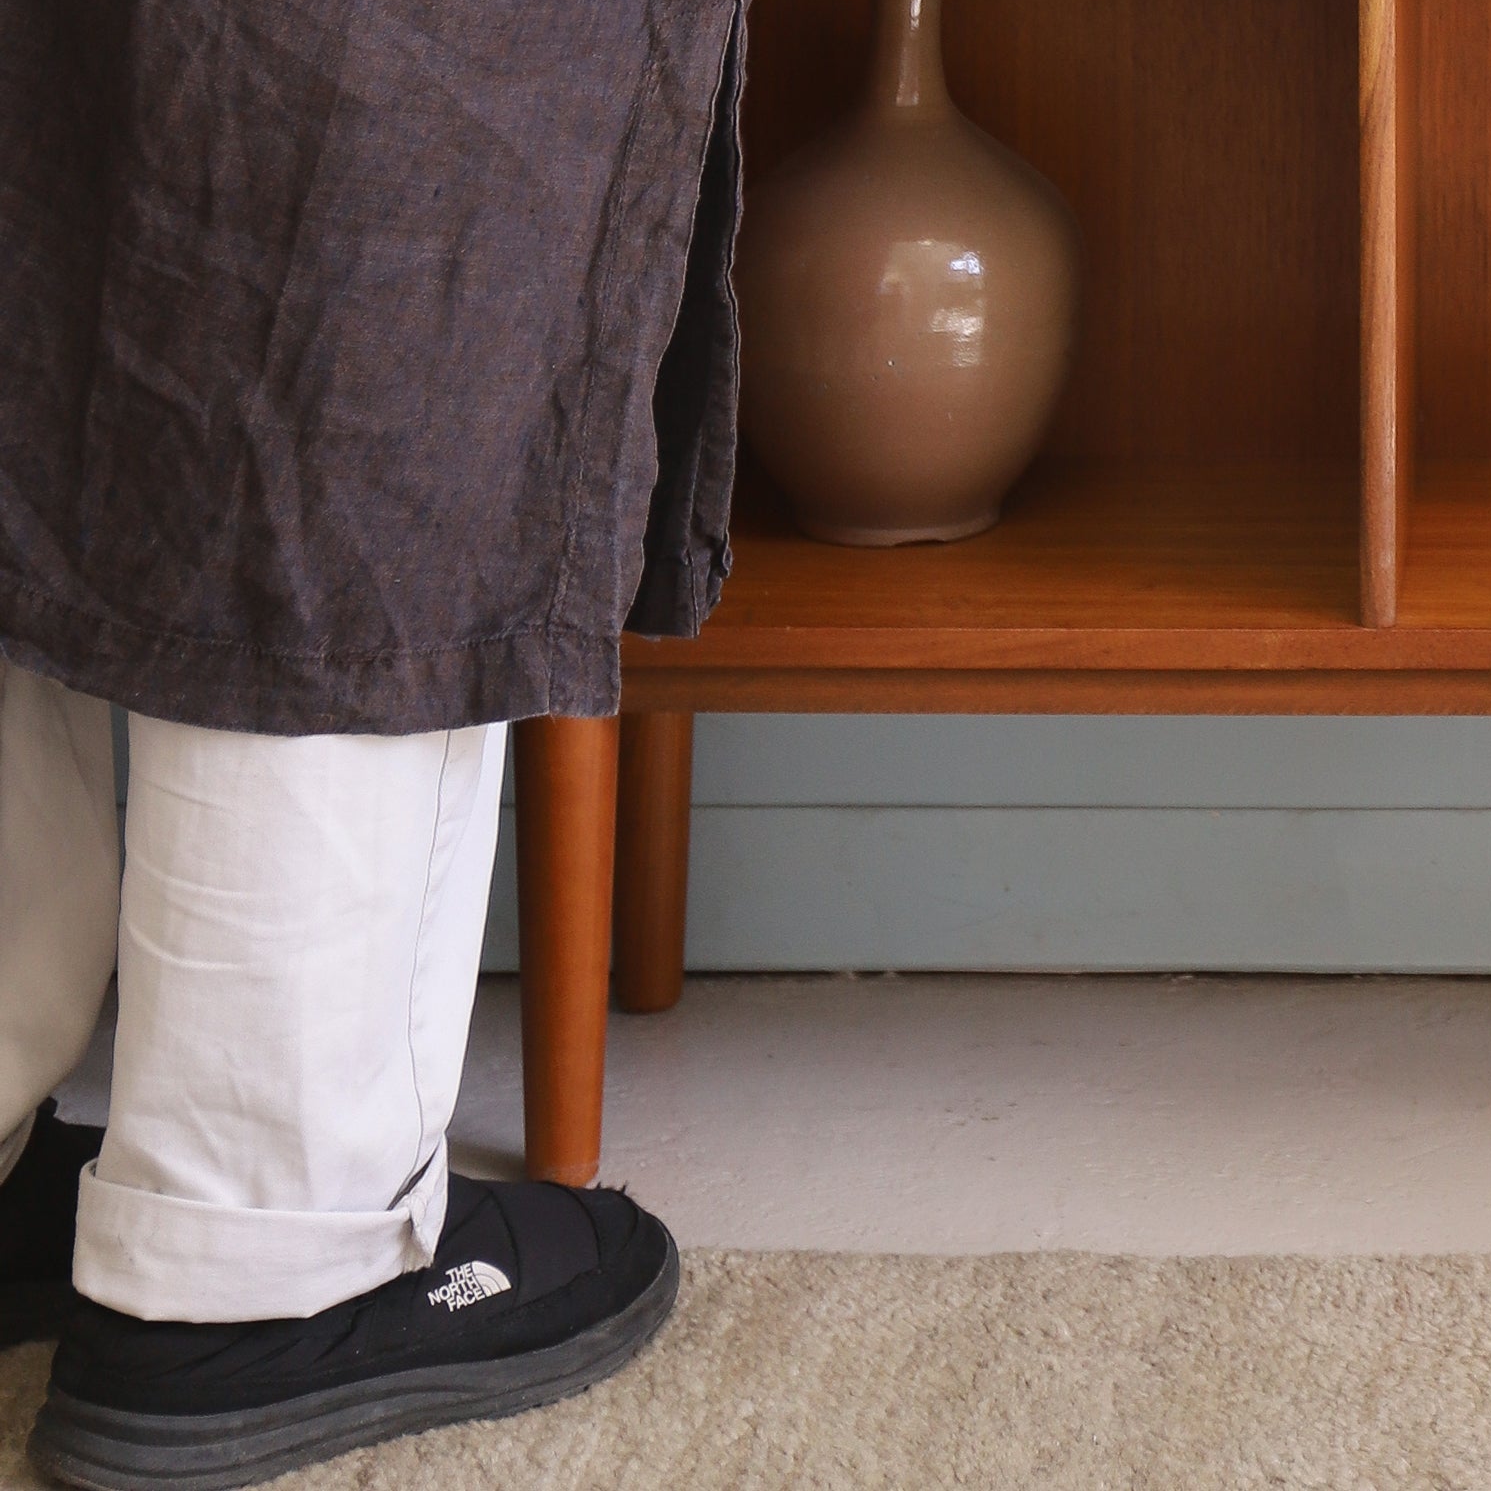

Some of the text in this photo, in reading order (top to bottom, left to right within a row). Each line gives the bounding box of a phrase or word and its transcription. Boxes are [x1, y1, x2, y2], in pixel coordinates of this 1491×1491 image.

[445, 1262, 473, 1284] THE
[427, 1275, 481, 1306] NORTH
[446, 1289, 486, 1312] FACE
